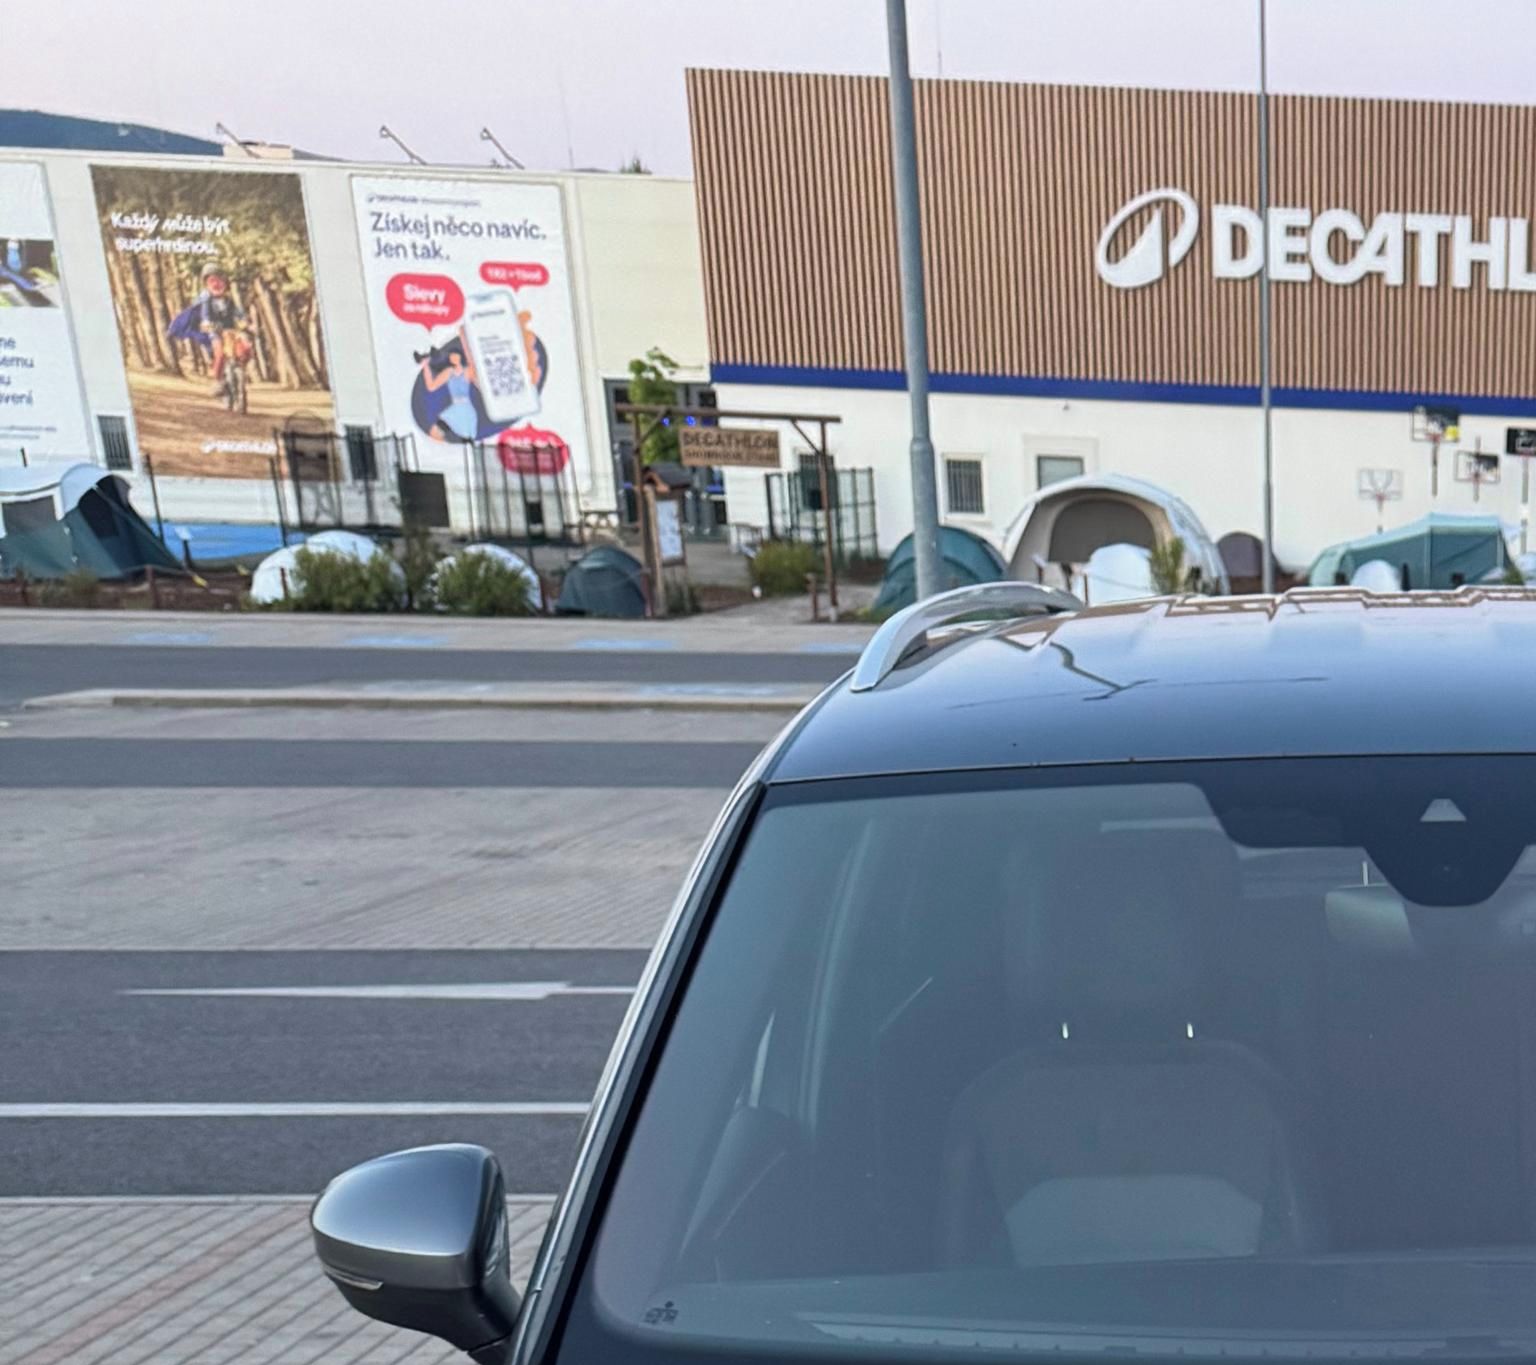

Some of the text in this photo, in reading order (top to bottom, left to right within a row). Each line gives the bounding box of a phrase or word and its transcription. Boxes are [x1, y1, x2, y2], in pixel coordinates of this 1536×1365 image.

[369, 211, 547, 240] Získej něco navíc.
[374, 236, 451, 261] Jen tak.
[402, 283, 446, 305] Slevy
[683, 431, 778, 449] DECATHLON
